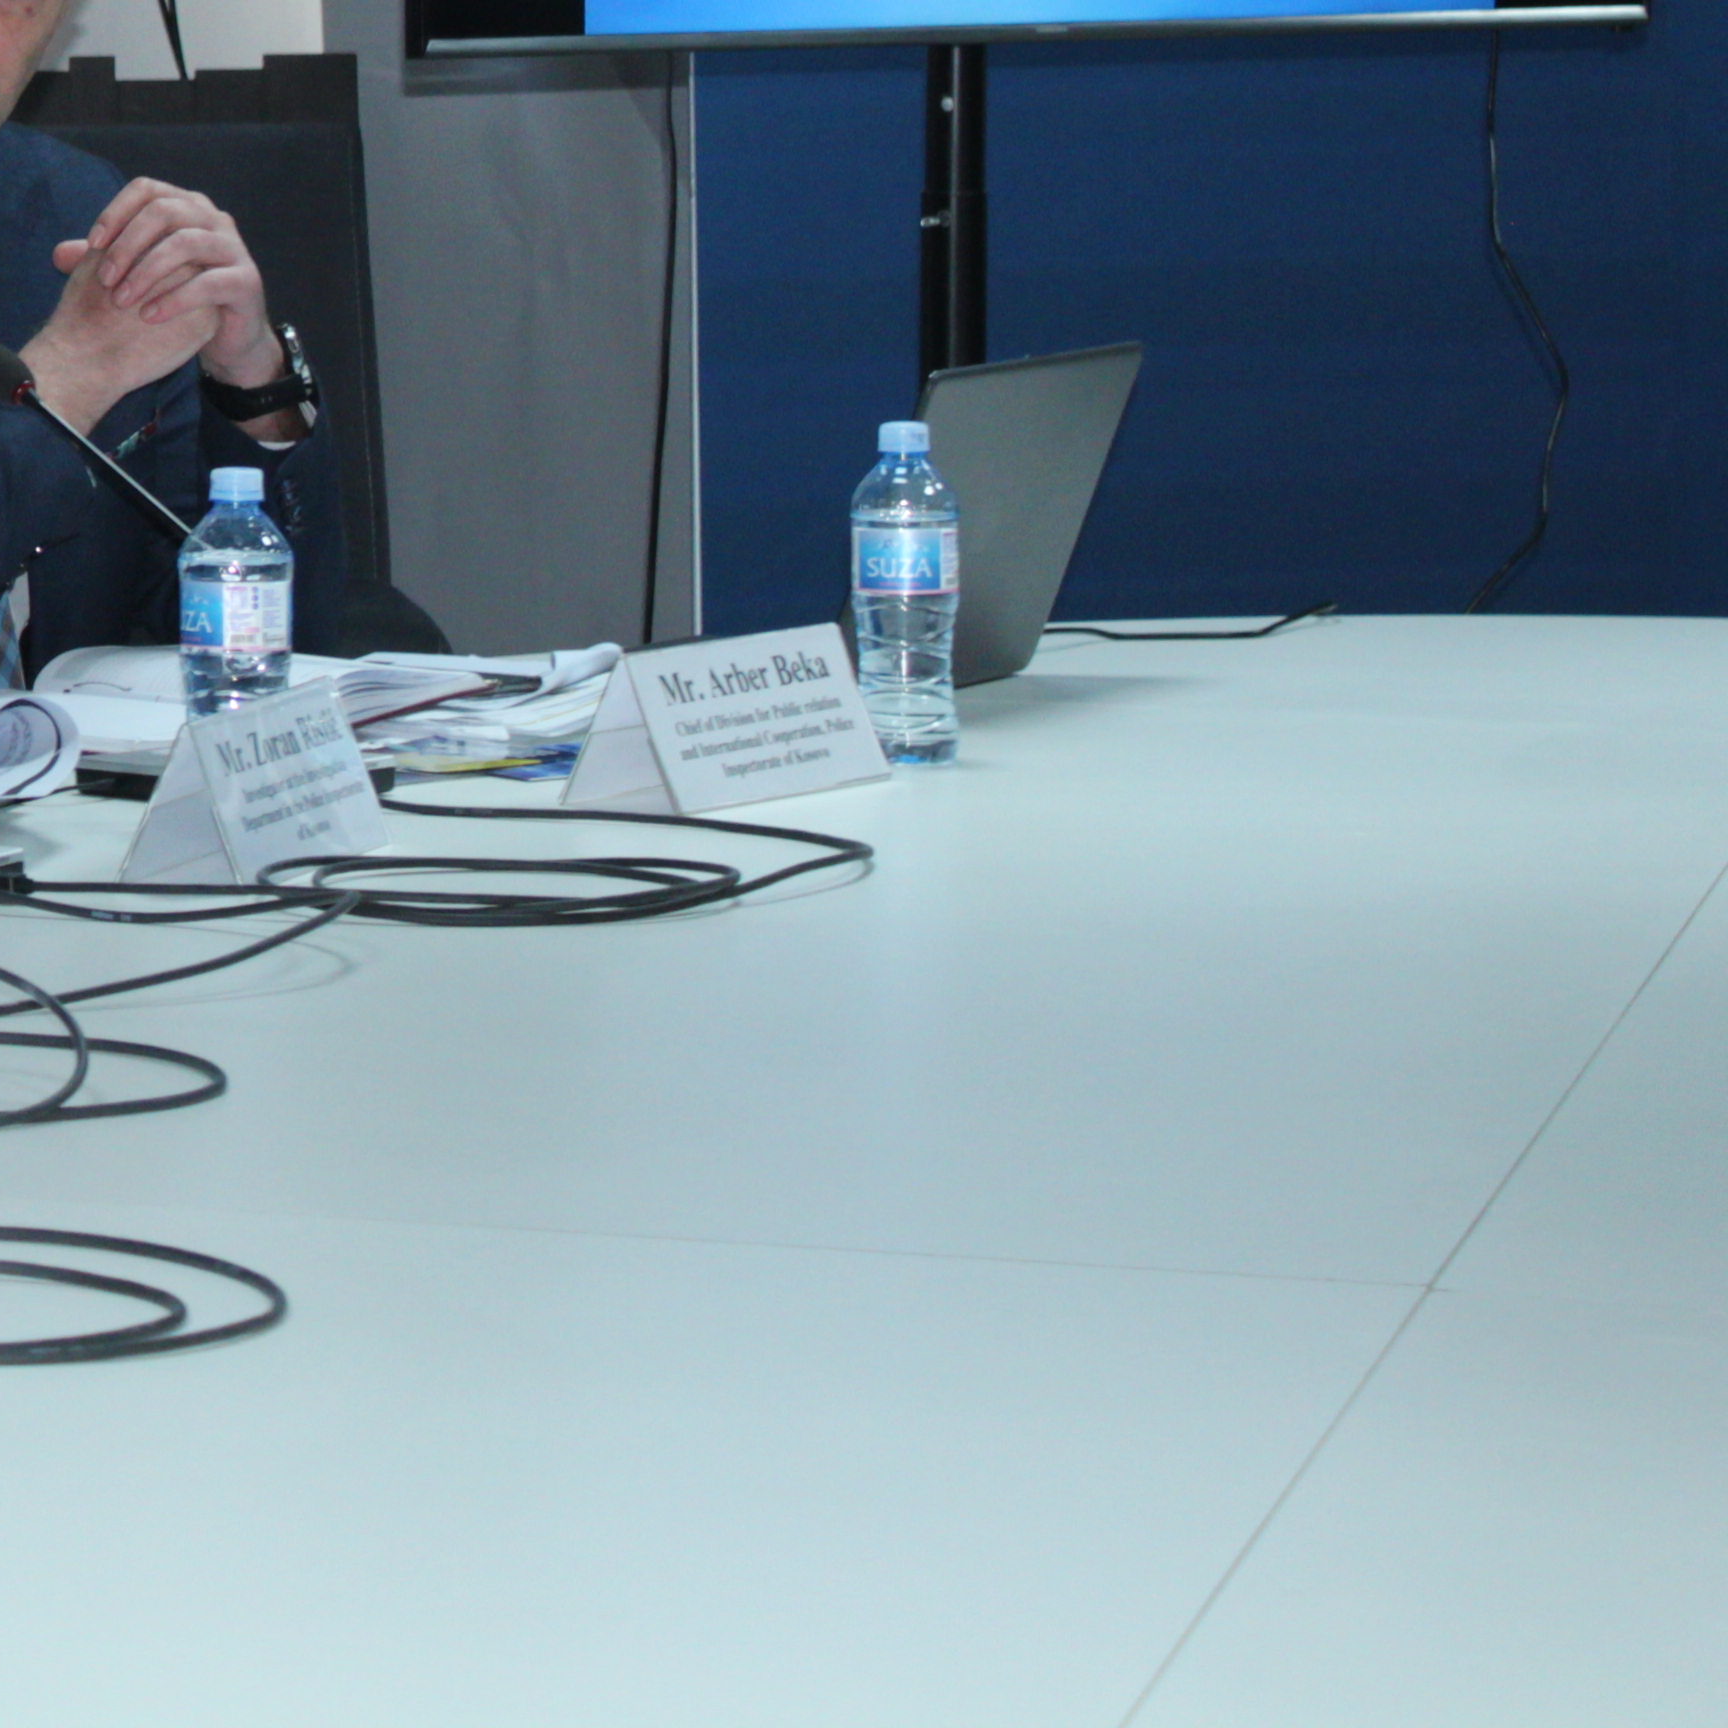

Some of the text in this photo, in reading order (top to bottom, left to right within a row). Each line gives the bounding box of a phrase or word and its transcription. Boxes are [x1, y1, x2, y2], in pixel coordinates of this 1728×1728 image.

[867, 557, 932, 578] SUZA
[659, 653, 830, 706] Mr. Arber Beka
[247, 732, 300, 766] Zoran
